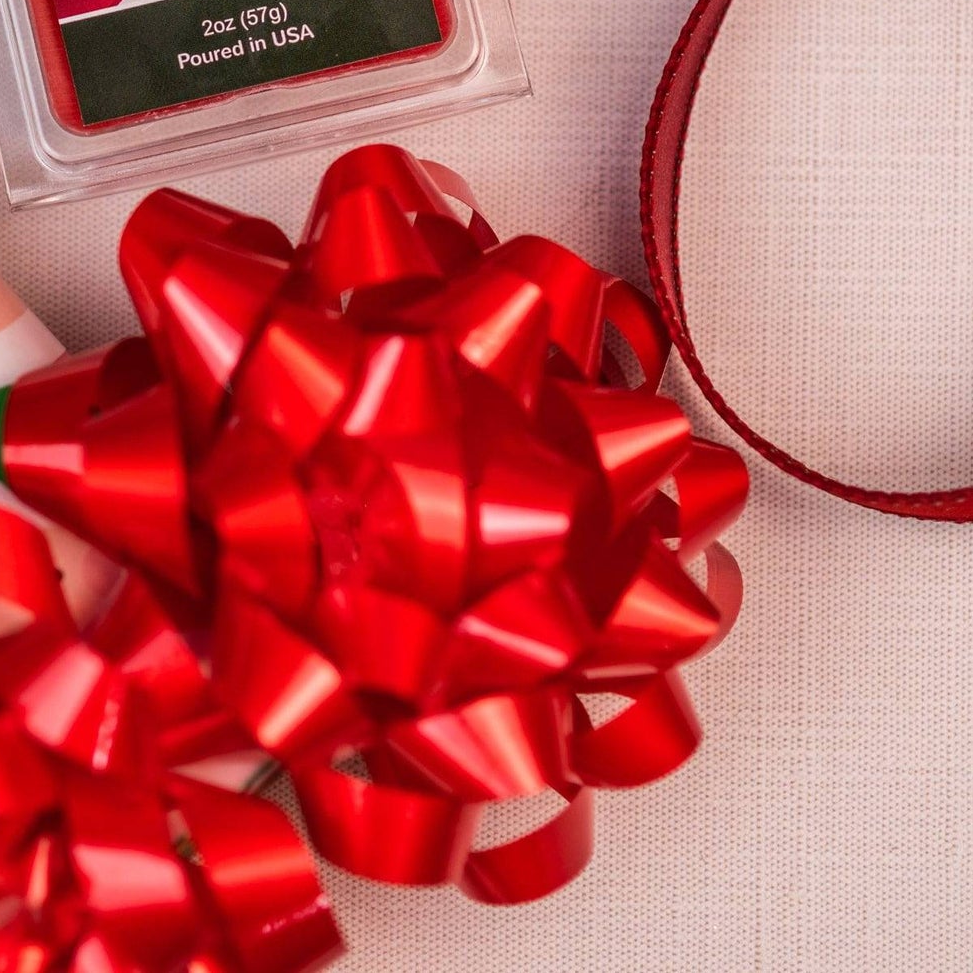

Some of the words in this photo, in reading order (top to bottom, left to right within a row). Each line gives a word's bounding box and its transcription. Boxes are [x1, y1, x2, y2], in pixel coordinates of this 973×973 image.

[201, 16, 237, 37] 2oz
[240, 2, 288, 31] (57g)
[176, 38, 245, 70] Poured
[248, 34, 267, 53] in
[270, 23, 315, 49] USA
